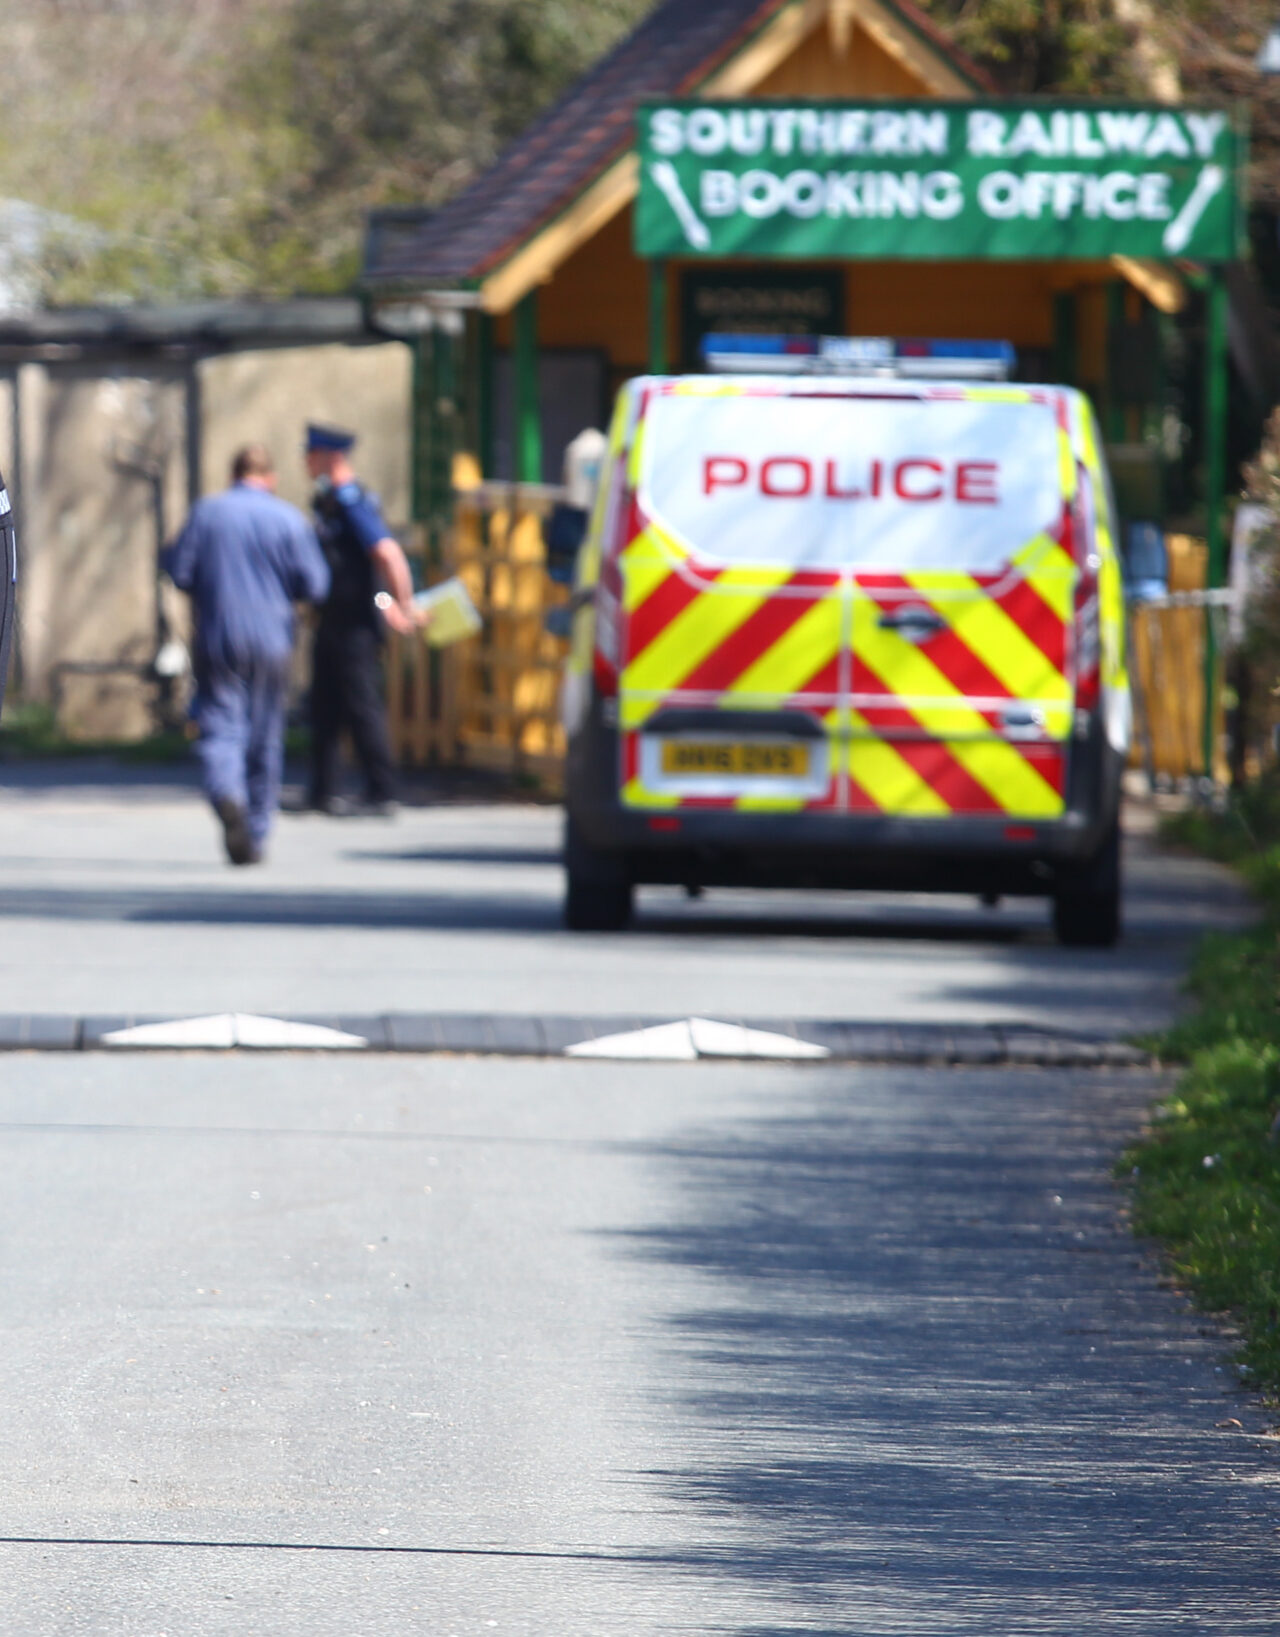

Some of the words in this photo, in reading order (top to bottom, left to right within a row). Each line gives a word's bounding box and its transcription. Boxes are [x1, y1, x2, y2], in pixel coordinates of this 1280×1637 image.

[649, 108, 949, 155] SOUTHERN
[966, 110, 1227, 158] RAILWAY
[699, 168, 964, 220] BOOKING
[976, 170, 1171, 221] OFFICE
[702, 456, 1000, 505] POLICE
